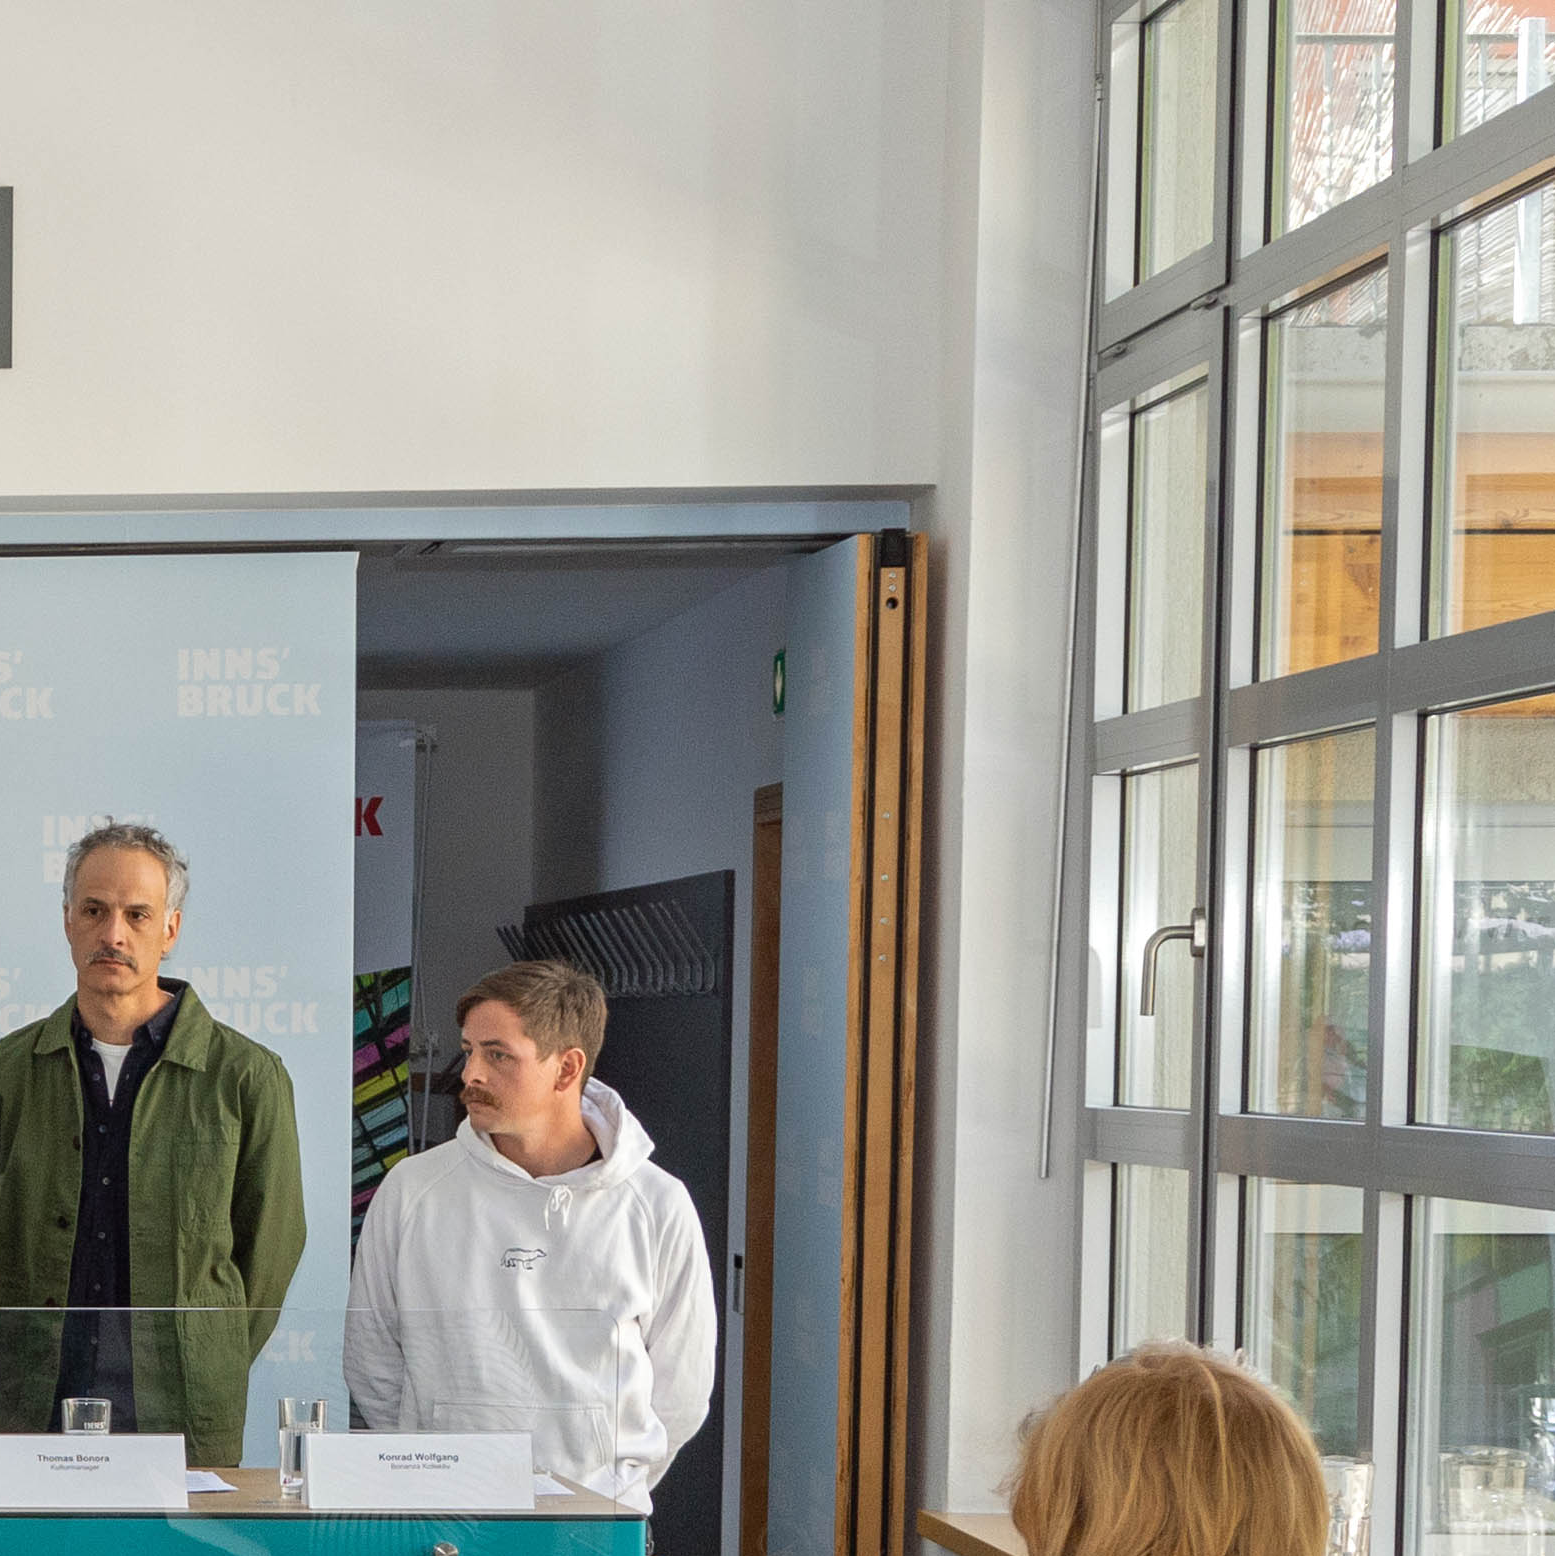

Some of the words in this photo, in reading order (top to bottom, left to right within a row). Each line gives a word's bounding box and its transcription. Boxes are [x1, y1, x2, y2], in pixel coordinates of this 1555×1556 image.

[176, 647, 290, 681] INNS'
[176, 683, 322, 718] BRUCK
[37, 1454, 74, 1462] Thomas
[76, 1454, 110, 1462] Bonora
[378, 1452, 412, 1461] Konrad
[414, 1452, 459, 1463] Wolfgang
